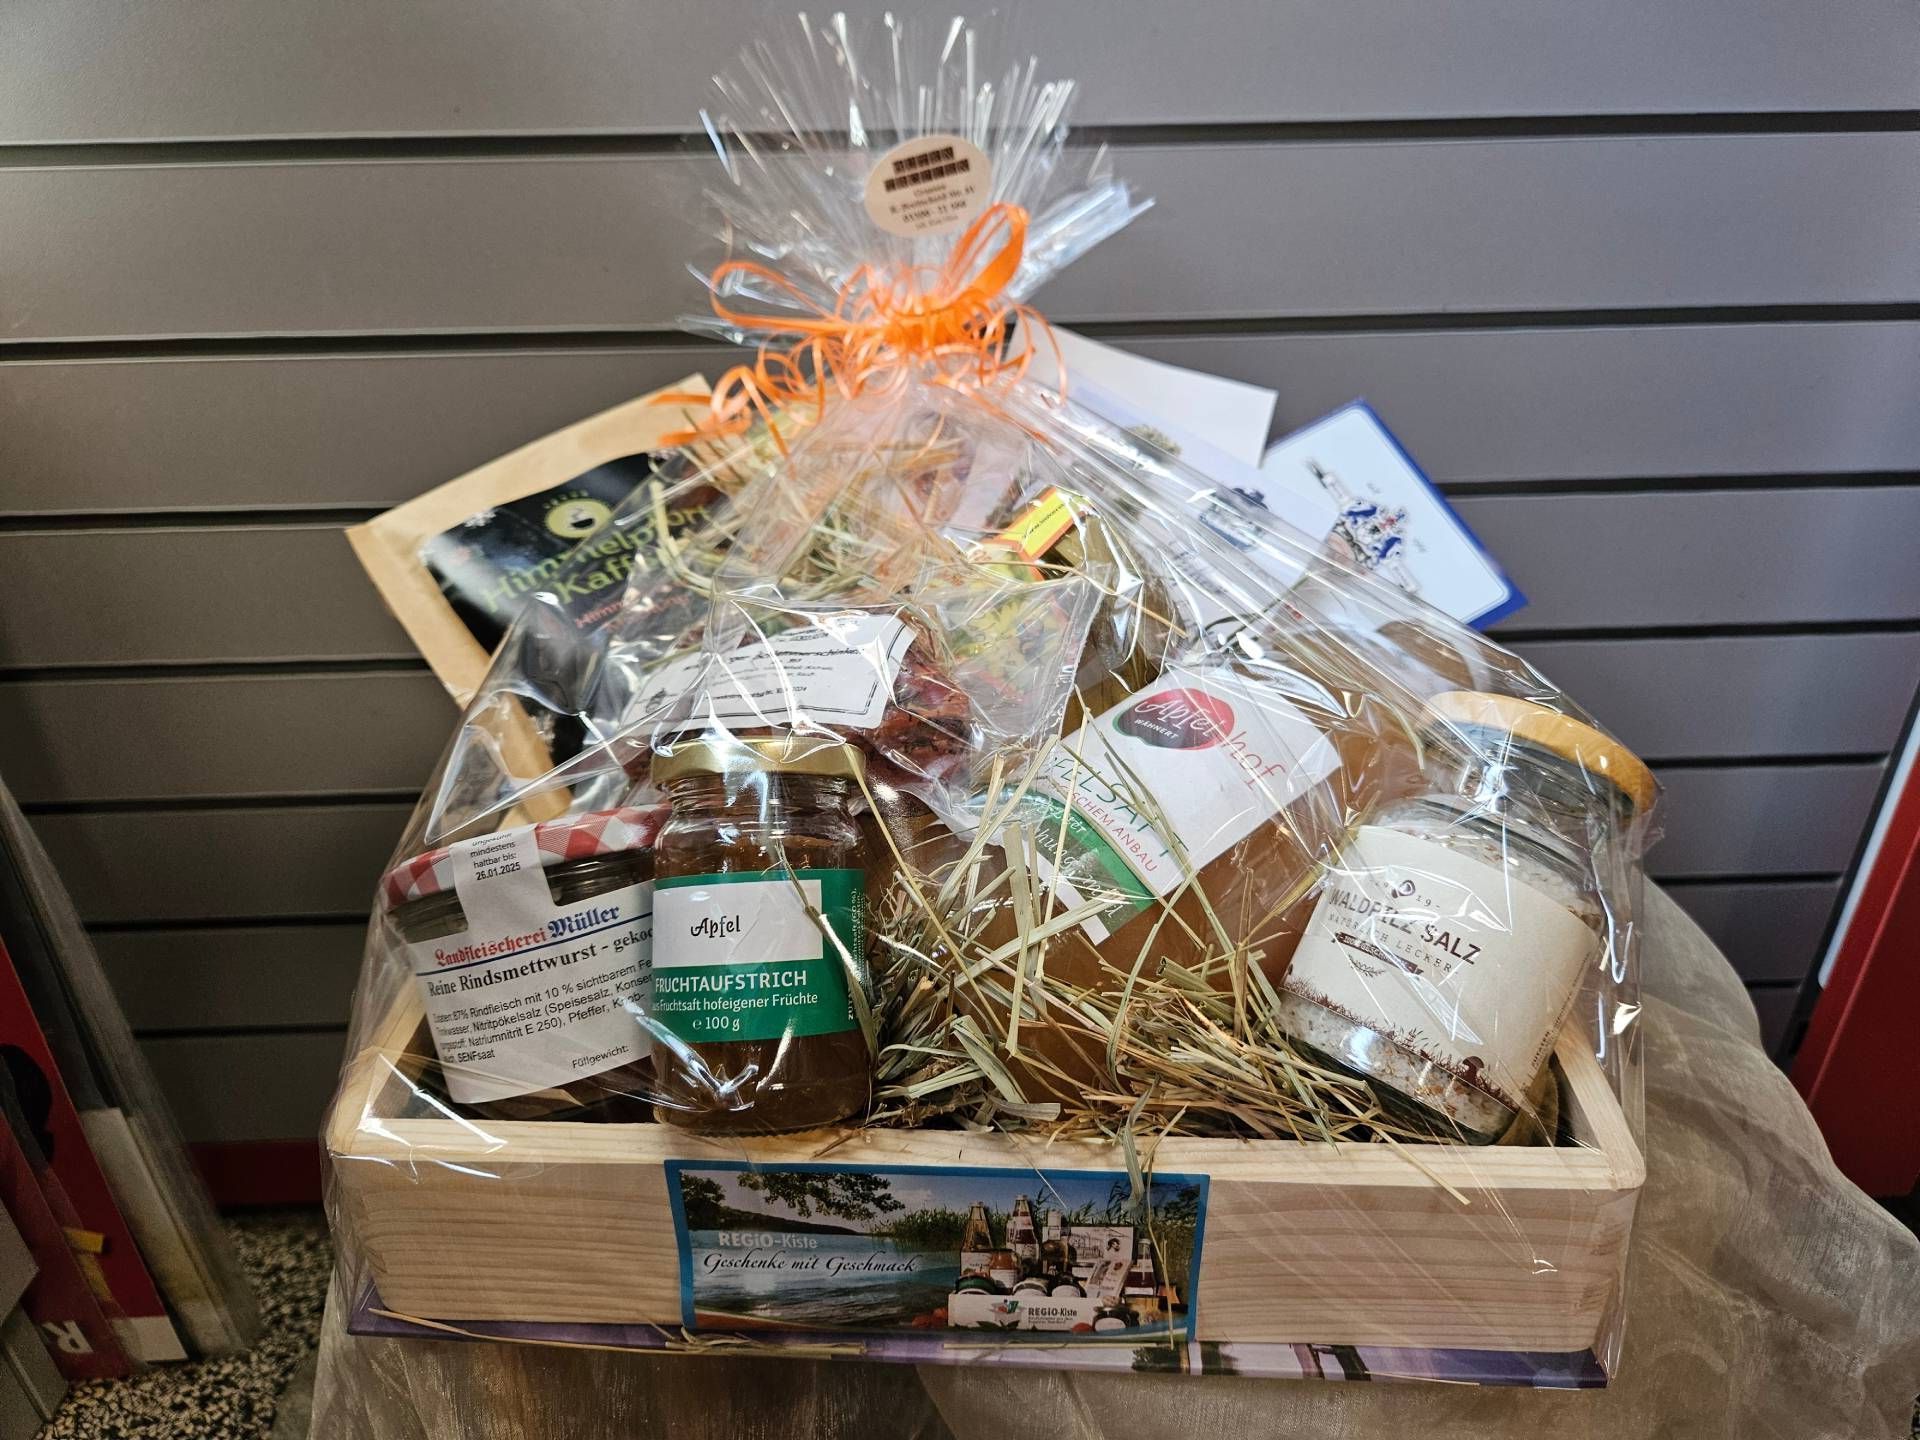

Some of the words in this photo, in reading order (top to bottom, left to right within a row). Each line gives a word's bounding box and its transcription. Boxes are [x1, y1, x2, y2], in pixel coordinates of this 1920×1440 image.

[483, 505, 711, 614] Himmelport
[553, 551, 661, 605] Kaff
[1134, 719, 1179, 739] WÄHNERT
[470, 841, 516, 858] mindestens
[473, 856, 501, 869] haltbar
[502, 852, 517, 862] bis:
[1112, 826, 1158, 873] ANBAU
[475, 861, 521, 881] 26.01.2025
[434, 927, 547, 967] Landfleischerei
[547, 904, 620, 939] Müller
[690, 914, 741, 938] Apfel
[1420, 922, 1482, 965] SALZ
[428, 980, 457, 997] Reine
[459, 943, 597, 991] Rindsmettwurst
[654, 970, 807, 993] FRUCHTAUFSTRICH
[469, 997, 522, 1018] Rindfleisch
[524, 992, 542, 1005] mit
[545, 987, 559, 999] 10
[561, 982, 574, 994] %
[576, 964, 636, 991] sichtbarem
[660, 998, 702, 1012] Fruchtsaft
[703, 995, 769, 1013] hofeigener
[772, 991, 818, 1007] Früchte
[468, 1027, 523, 1046] Natriumnitrit
[525, 1023, 534, 1035] E
[536, 1016, 566, 1031] 250),
[568, 1004, 610, 1022] Pfeffer,
[612, 993, 646, 1008] Kob-
[472, 1008, 541, 1031] Nitritpökelsalz
[544, 988, 613, 1016] (Speisesalz,
[705, 1016, 729, 1030] 100
[733, 1018, 740, 1031] g
[457, 1048, 496, 1063] SENFsaat
[572, 1045, 629, 1069] Füllgewicht:
[703, 1248, 786, 1275] Geschenke
[791, 1254, 820, 1270] mit
[826, 1250, 924, 1277] Geschmack
